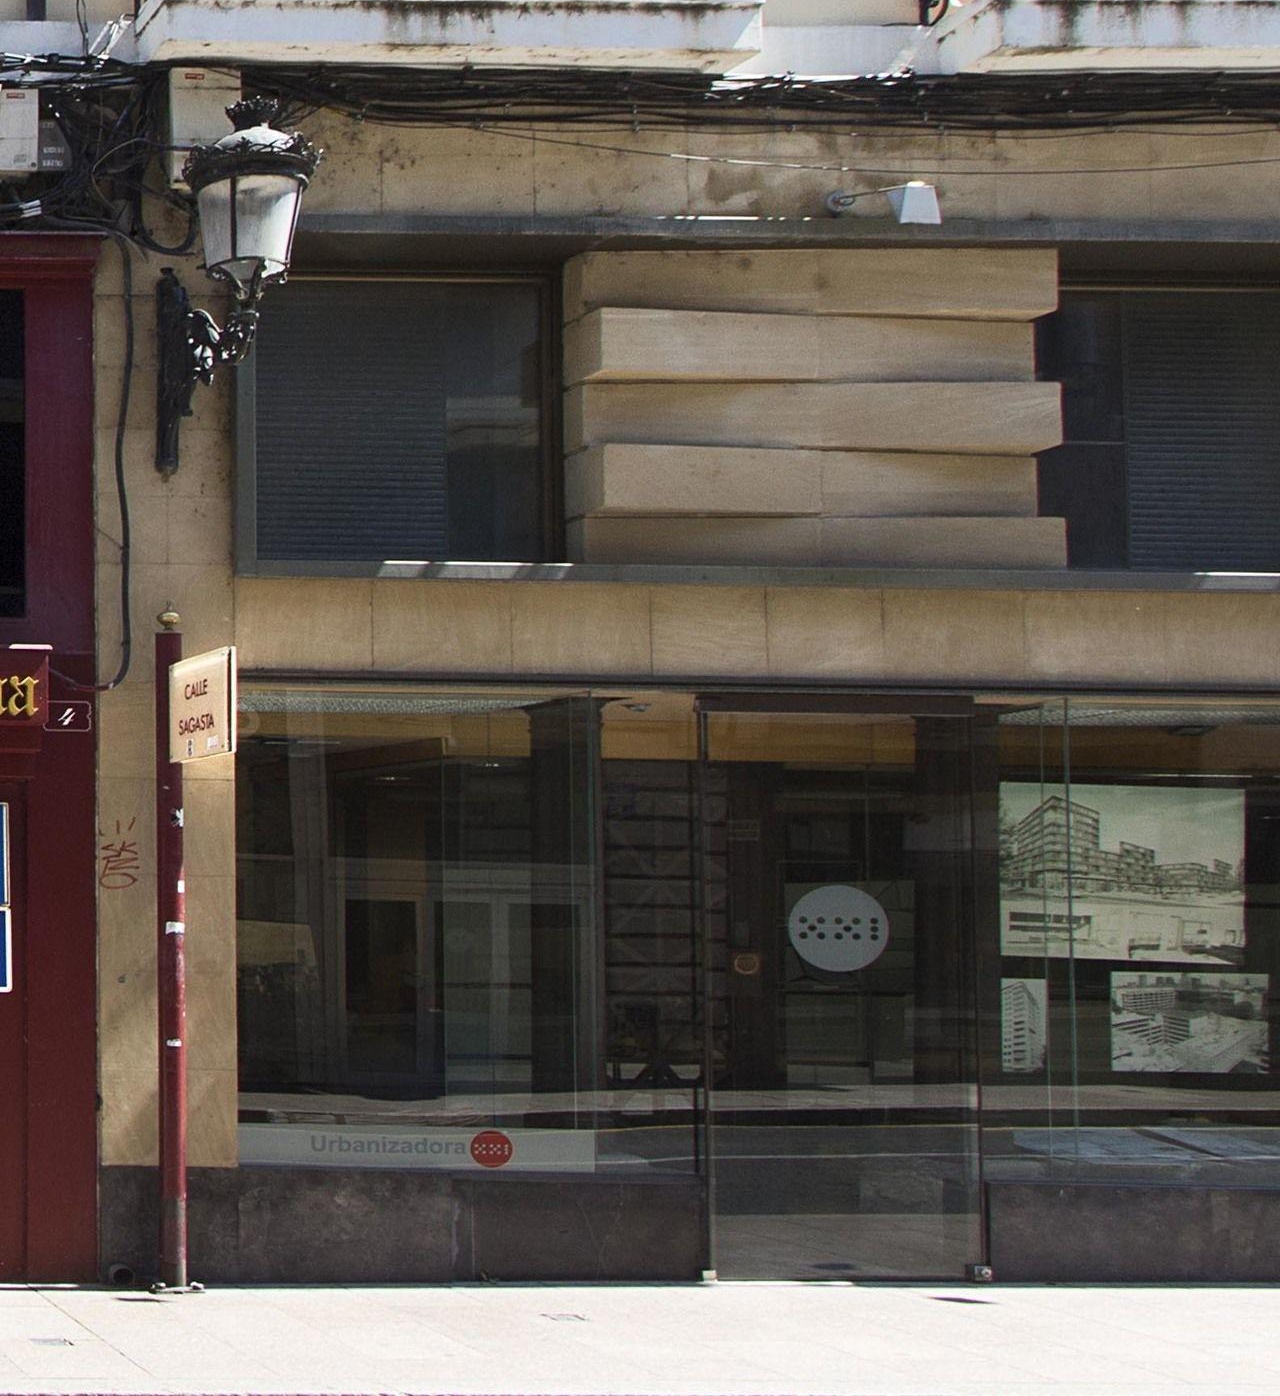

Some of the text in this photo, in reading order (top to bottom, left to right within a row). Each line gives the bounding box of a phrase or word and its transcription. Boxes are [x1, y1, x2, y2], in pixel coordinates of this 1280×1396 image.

[184, 679, 208, 700] CALLE
[57, 707, 76, 726] 4
[178, 713, 215, 736] SAGASTA
[311, 1135, 467, 1155] Urbanizadora
